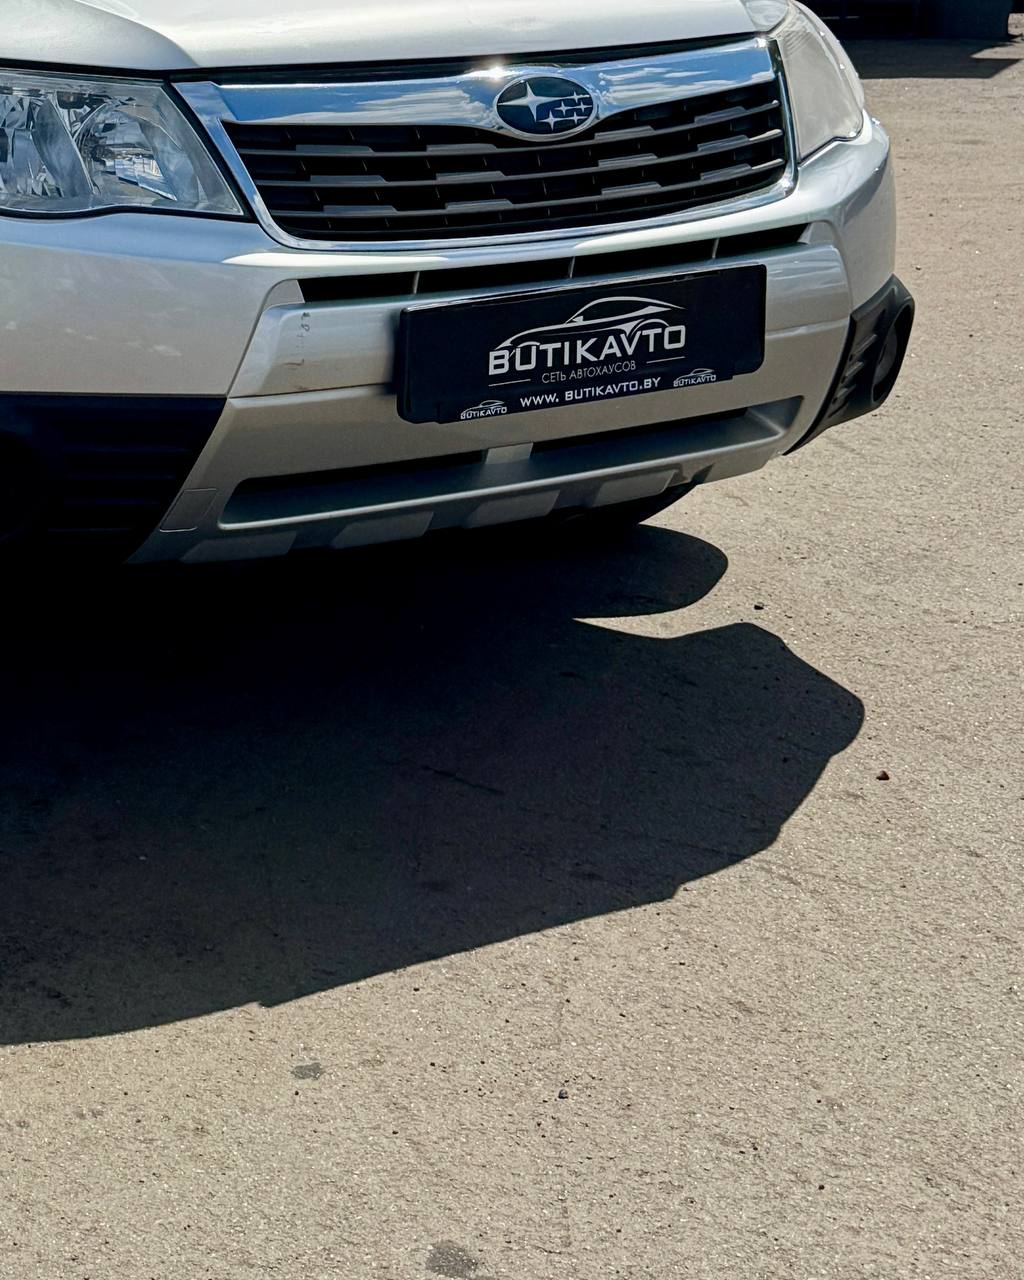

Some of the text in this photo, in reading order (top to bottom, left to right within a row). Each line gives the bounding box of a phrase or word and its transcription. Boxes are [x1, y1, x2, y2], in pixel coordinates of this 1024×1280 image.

[488, 324, 686, 376] BUTIKAVTO
[541, 360, 637, 384] СЕТЬ АВТОХАУСОВ
[564, 376, 661, 402] BUTIKAVTO.BY
